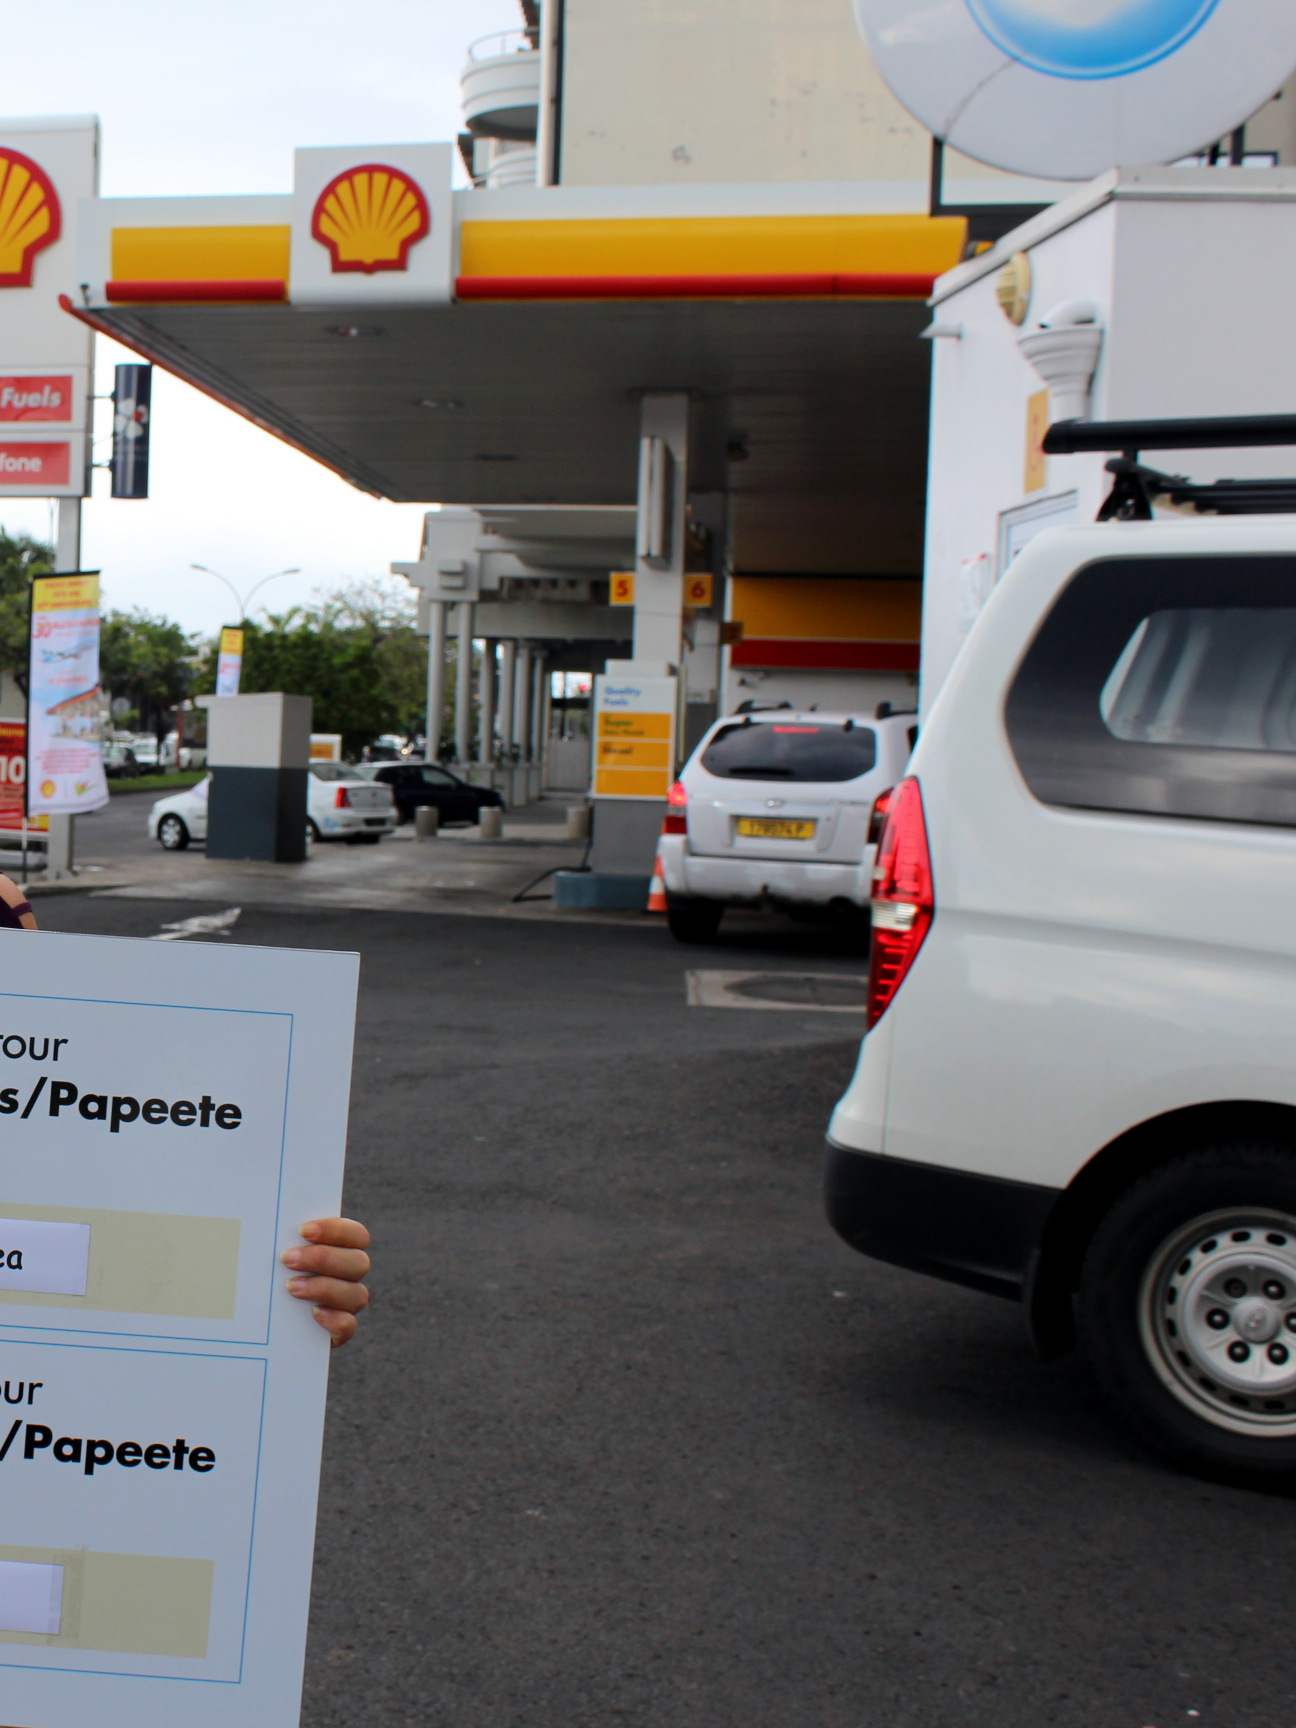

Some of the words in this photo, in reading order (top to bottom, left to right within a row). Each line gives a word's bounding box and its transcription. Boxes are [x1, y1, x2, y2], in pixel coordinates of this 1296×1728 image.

[0, 386, 62, 408] Fuels
[616, 579, 629, 597] 5
[691, 580, 707, 599] 6
